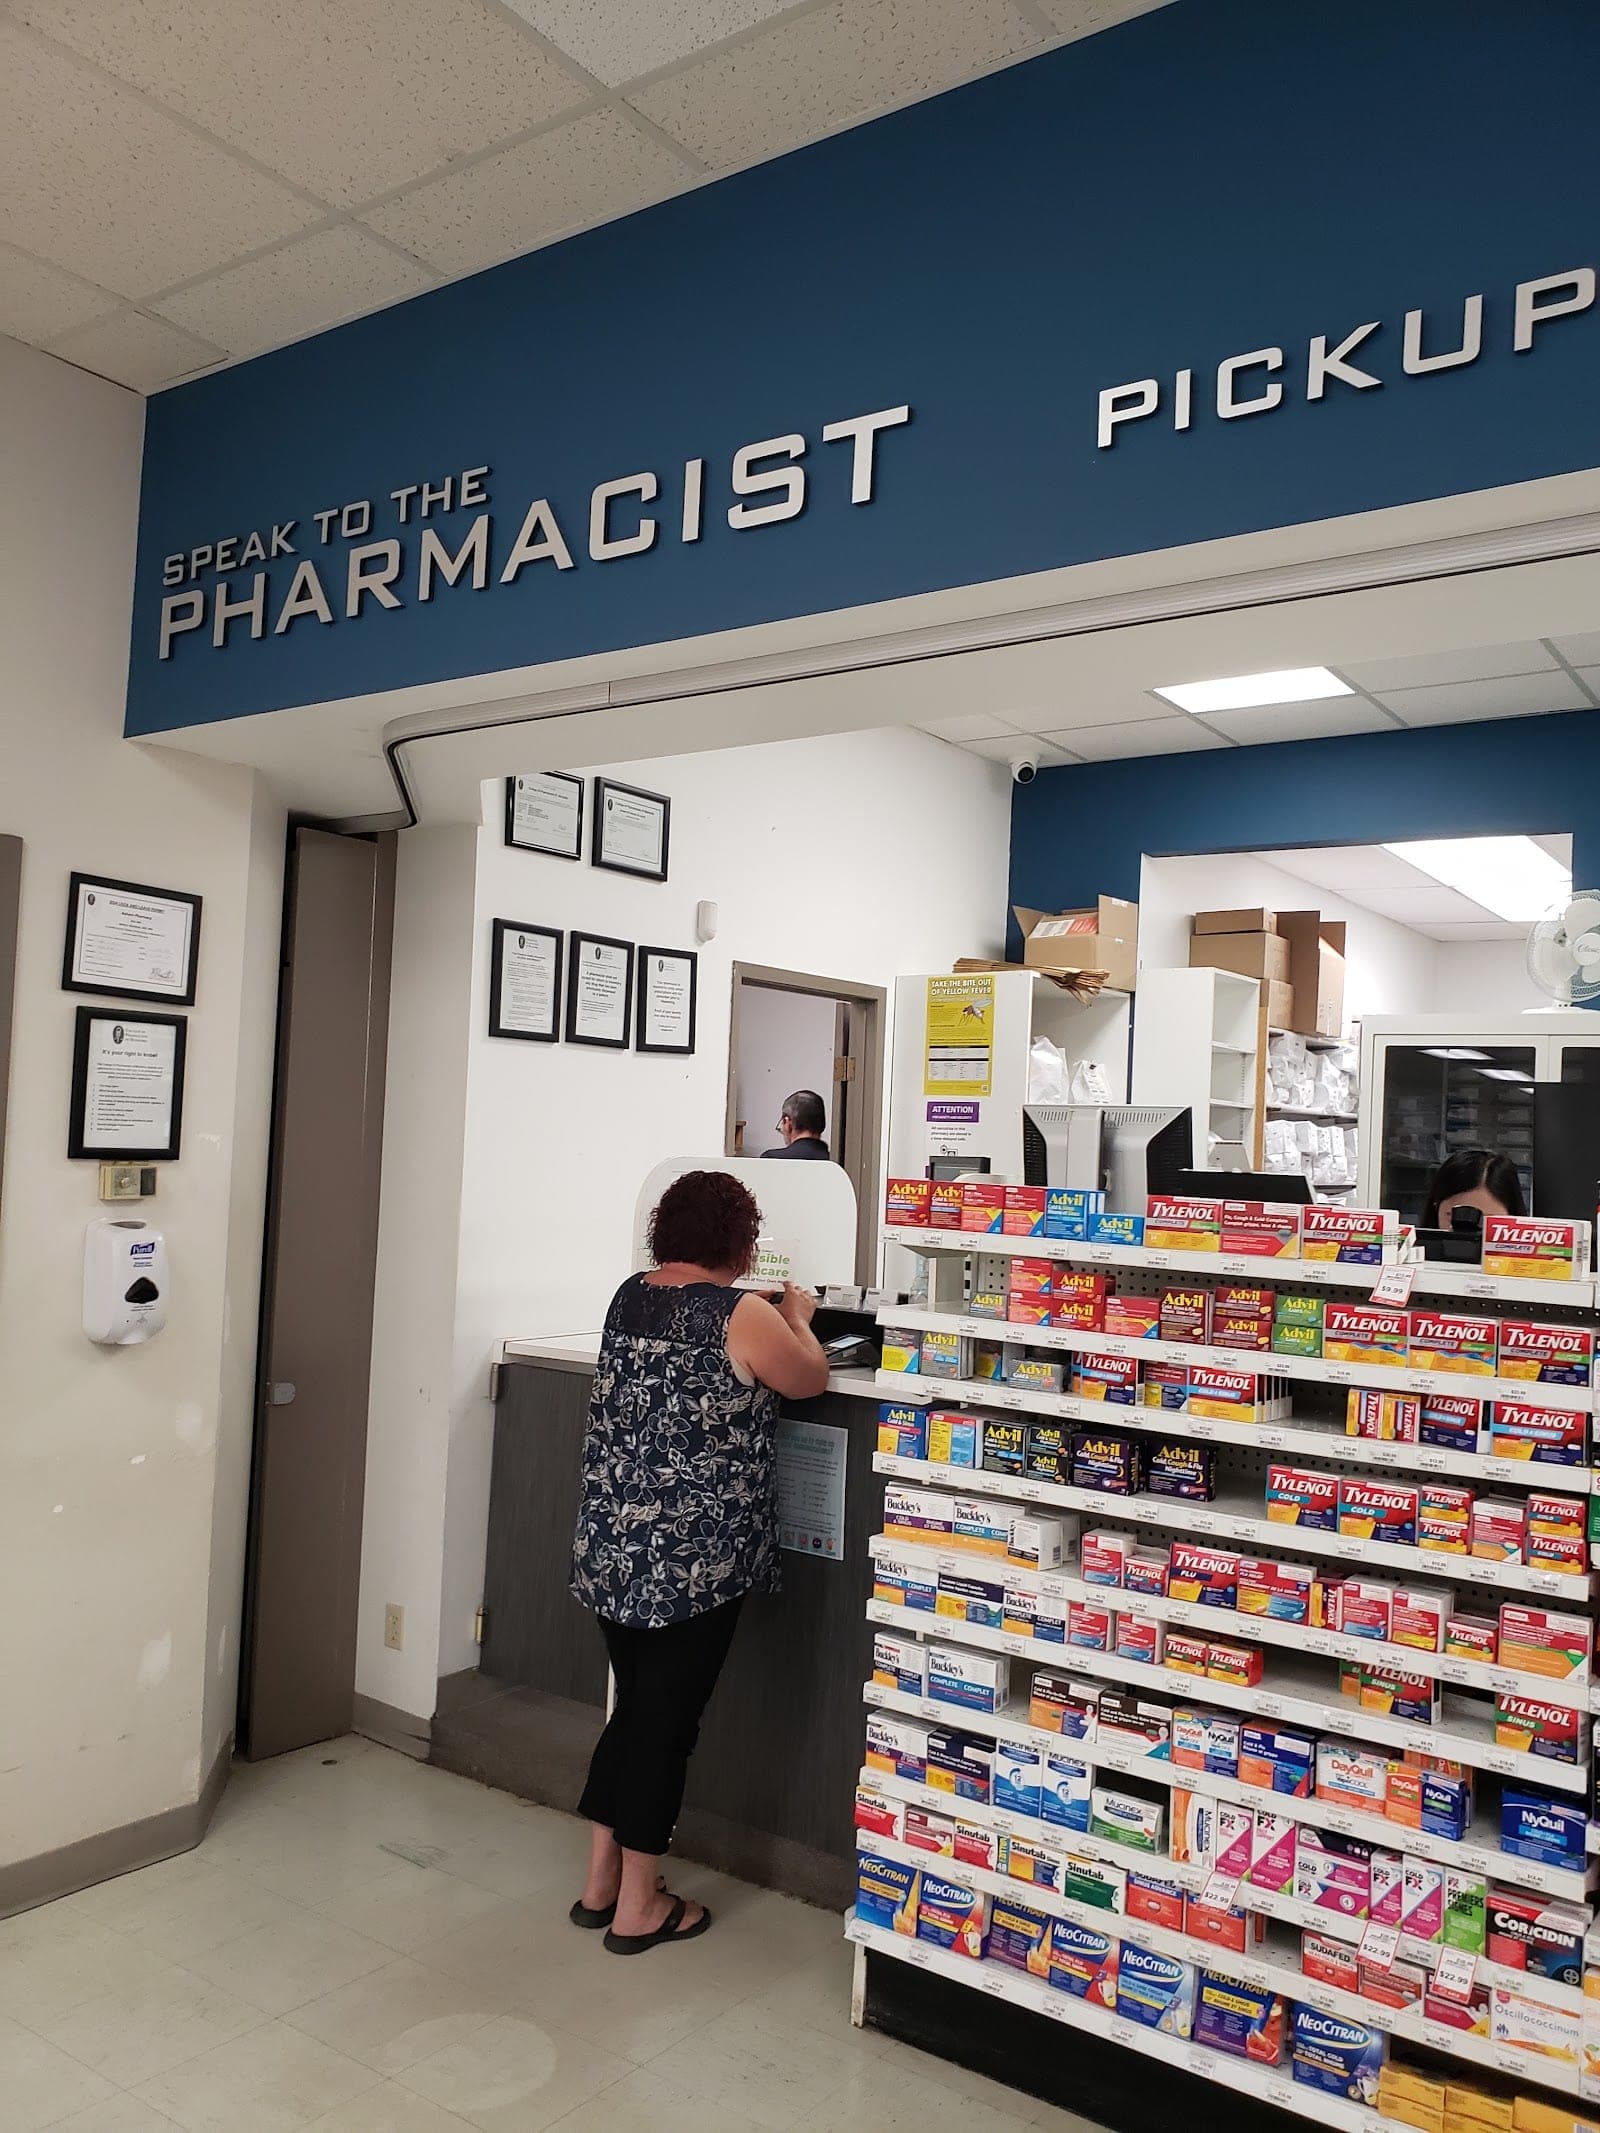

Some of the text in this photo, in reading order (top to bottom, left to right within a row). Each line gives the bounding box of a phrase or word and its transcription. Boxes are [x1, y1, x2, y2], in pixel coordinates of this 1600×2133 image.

[1098, 267, 1596, 449] PICKUP
[158, 404, 910, 660] PHARMACIST
[162, 465, 491, 587] SPEAK TO THE
[949, 979, 960, 987] THE
[978, 978, 992, 986] OUT
[932, 1105, 974, 1113] ATTENTION
[889, 1183, 928, 1195] Advil
[932, 1186, 963, 1197] Advi
[1049, 1193, 1083, 1206] Advil
[1152, 1202, 1214, 1220] TYLENOL
[1098, 1217, 1133, 1230] Advil
[1310, 1213, 1377, 1232] TYLENOL
[1491, 1224, 1567, 1245] TYLENOL
[1059, 1274, 1094, 1288] Advil
[973, 1293, 1002, 1305] Advil
[1163, 1292, 1204, 1308] Advil
[1228, 1289, 1261, 1301] Advil
[1284, 1297, 1317, 1310] Advil
[1059, 1302, 1094, 1316] Advil
[1226, 1320, 1258, 1332] Advil
[1331, 1312, 1400, 1333] TYLENOL
[1416, 1319, 1487, 1342] TYLENOL
[923, 1332, 957, 1346] Advil
[1280, 1326, 1315, 1339] Advil
[1506, 1328, 1582, 1351] TYLENOL
[1016, 1363, 1051, 1376] Advil
[1085, 1354, 1133, 1374] TYLENOL
[1192, 1368, 1250, 1390] TYLENOL
[1365, 1393, 1379, 1435] TYLENOL
[1426, 1395, 1475, 1416] TYLENOL
[887, 1409, 915, 1421] Advil
[1403, 1402, 1415, 1441] TYLENOL
[1501, 1405, 1575, 1430] TYLENOL
[985, 1425, 1022, 1442] Advil
[1038, 1428, 1060, 1439] Advil
[1082, 1439, 1120, 1454] Advil
[1159, 1445, 1199, 1461] Advil
[1034, 1455, 1057, 1466] Advil
[1271, 1473, 1334, 1497] TYLENOL
[1278, 1492, 1300, 1502] COLD
[1344, 1486, 1411, 1511] TYLENOL
[1425, 1490, 1463, 1506] TYLENOL
[887, 1498, 921, 1514] Buckley's
[1351, 1506, 1375, 1517] COLD
[1532, 1501, 1579, 1518] TYLENOL
[956, 1508, 991, 1524] Buckley's
[1424, 1523, 1462, 1538] TYLENOL
[1532, 1537, 1579, 1555] TYLENOL
[877, 1560, 907, 1577] Buckley's
[1126, 1564, 1162, 1580] TYLENOL
[1175, 1551, 1235, 1576] TYLENOL
[1180, 1569, 1196, 1578] FLU
[1006, 1594, 1037, 1611] Buckley's
[1450, 1628, 1488, 1645] TYLENOL
[875, 1647, 900, 1664] Buckley's
[1167, 1640, 1203, 1657] TYLENOL
[931, 1658, 963, 1676] Buckley's
[1210, 1650, 1247, 1669] TYLENOL
[1365, 1663, 1428, 1688] TYLENOL
[930, 1675, 989, 1695] COMPLETE COMPLET
[1371, 1679, 1396, 1690] SINUS
[1500, 1694, 1571, 1727] TYLENOL
[1507, 1715, 1535, 1729] SINUS
[868, 1727, 899, 1746] Buckley's
[1177, 1725, 1202, 1738] DayQuil
[1208, 1731, 1235, 1745] NyQuil
[1332, 1760, 1373, 1778] DayQuil
[1391, 1777, 1419, 1792] DayQuil
[857, 1793, 888, 1811] Sinutab
[1425, 1788, 1451, 1802] NyQuil
[1106, 1797, 1142, 1815] Mucinex
[1257, 1816, 1275, 1831] FX
[1522, 1810, 1565, 1832] NyQuil
[956, 1824, 991, 1842] Sinutab
[1011, 1841, 1046, 1860] Sinutab
[1067, 1861, 1104, 1881] Sinutab
[1405, 1868, 1424, 1880] COLD
[1405, 1875, 1424, 1891] FX
[1204, 1891, 1229, 1904] $22.99
[1494, 1912, 1576, 1949] CORICIDIN
[1310, 1942, 1350, 1963] SUDAFED
[1363, 1944, 1390, 1958] $22.99
[1439, 1971, 1468, 1985] $22.99
[1494, 2003, 1580, 2037] Oscillococcinum
